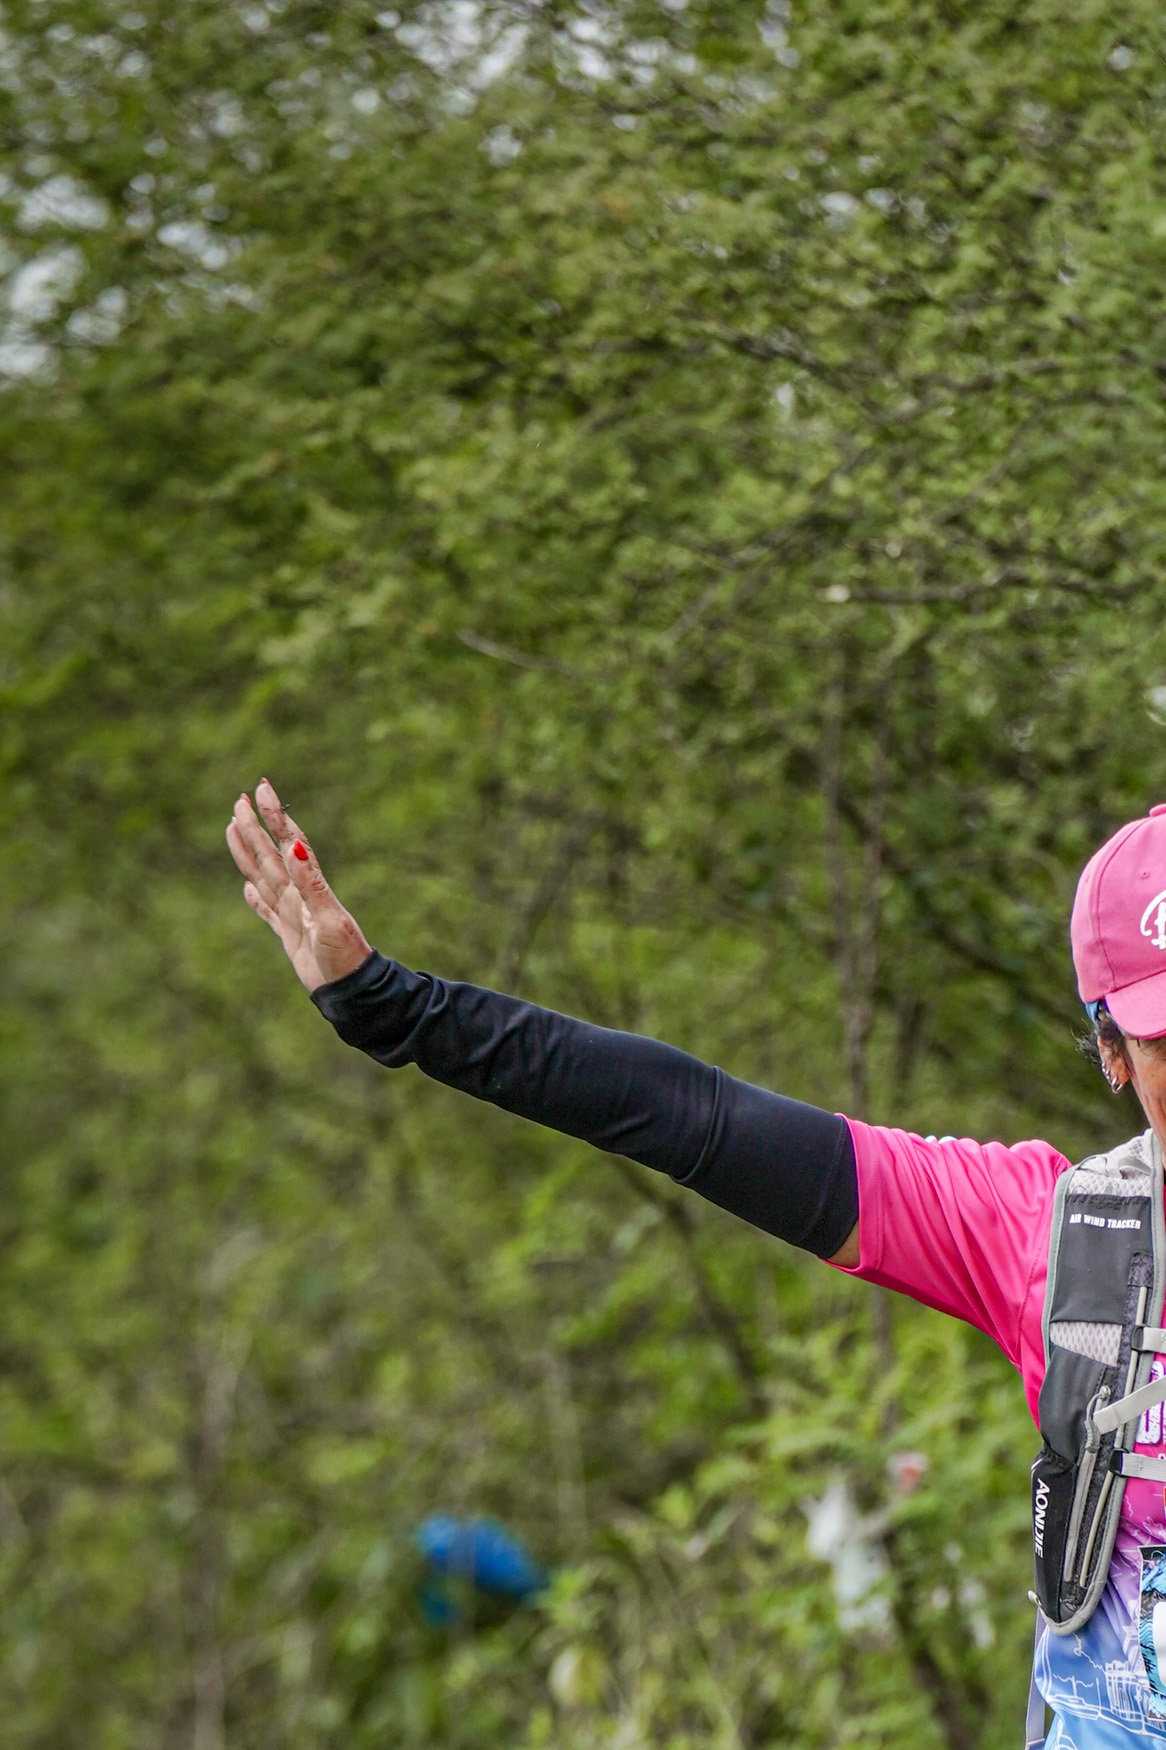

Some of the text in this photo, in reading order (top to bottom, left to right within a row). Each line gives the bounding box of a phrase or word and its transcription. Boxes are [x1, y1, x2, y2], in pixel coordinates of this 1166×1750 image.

[1069, 1213, 1141, 1230] AIR WIND TRACKER
[1035, 1478, 1050, 1558] AONIJIE
